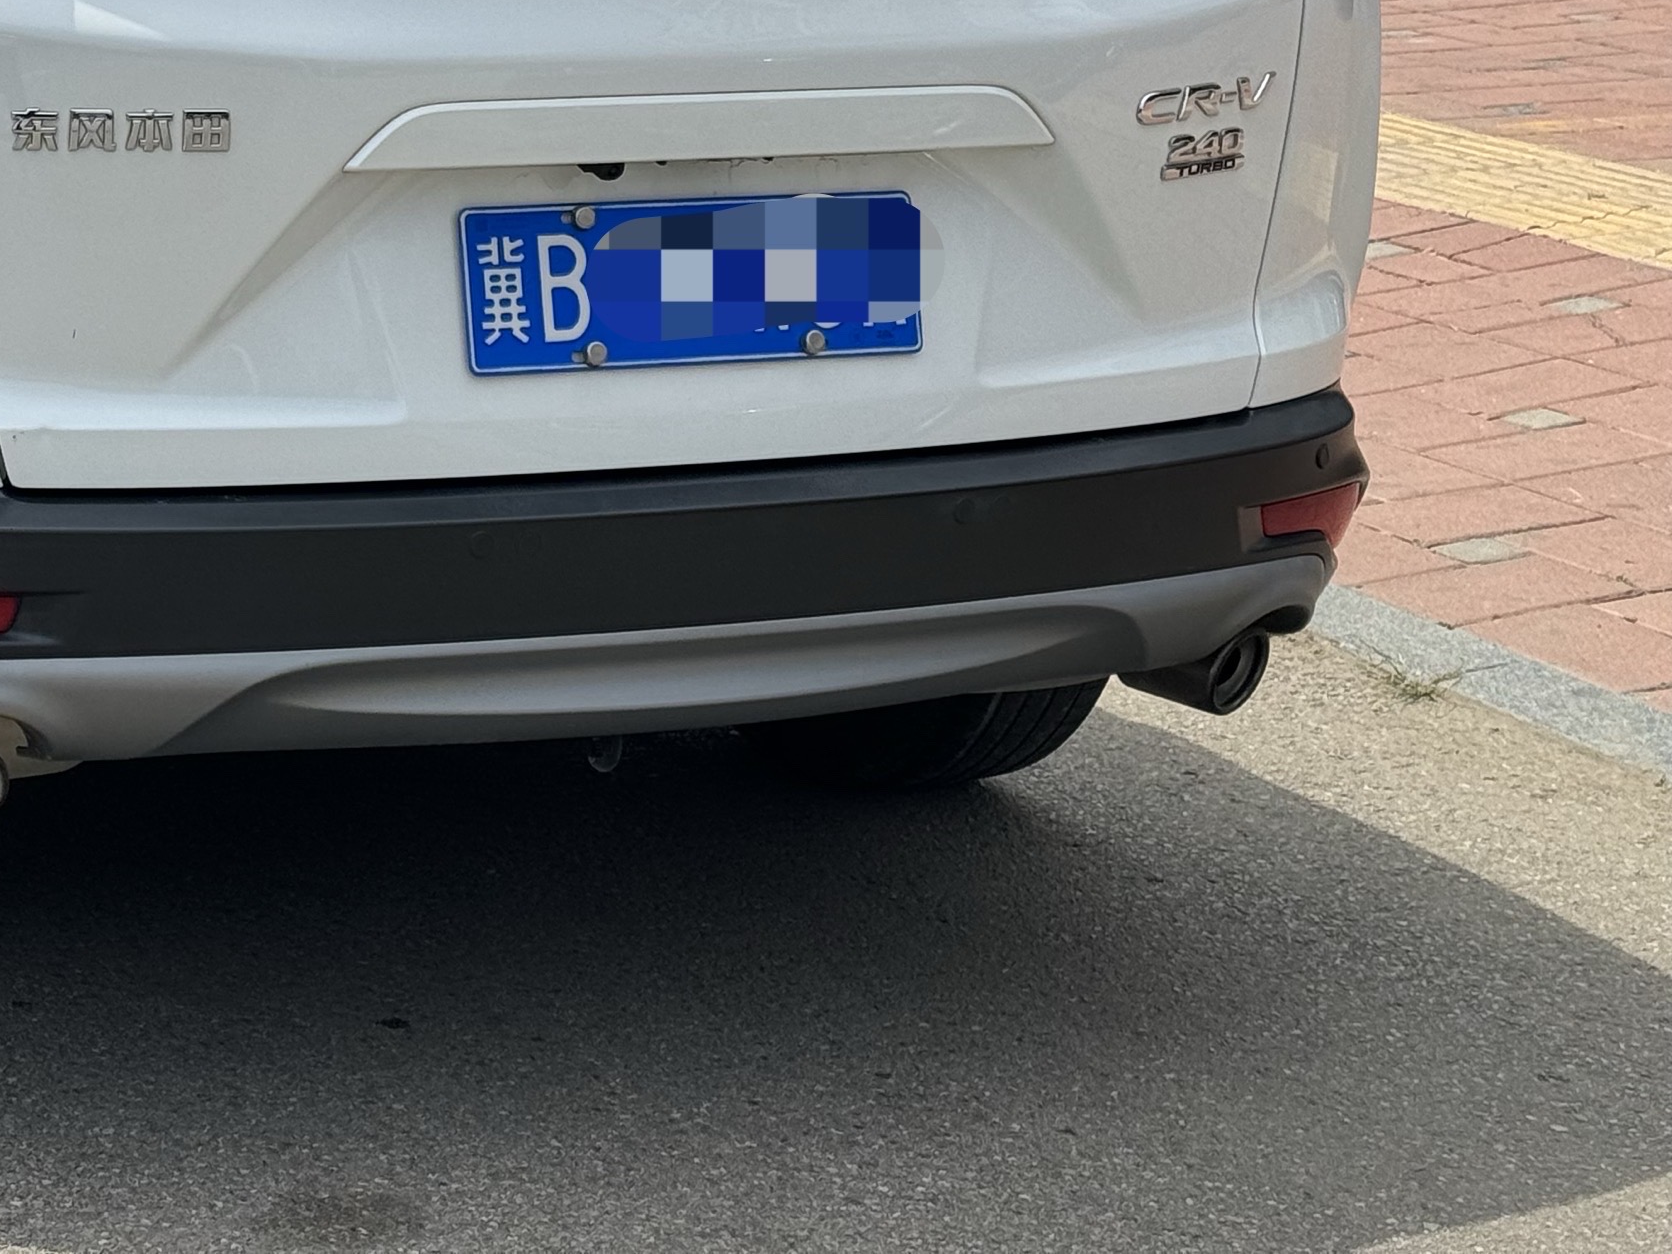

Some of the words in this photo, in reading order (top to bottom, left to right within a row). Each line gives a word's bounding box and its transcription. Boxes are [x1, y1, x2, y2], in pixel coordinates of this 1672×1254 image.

[1136, 71, 1277, 126] CR-V
[10, 107, 232, 152] 东风本田
[1166, 127, 1245, 164] 240
[1177, 158, 1236, 178] TURBO
